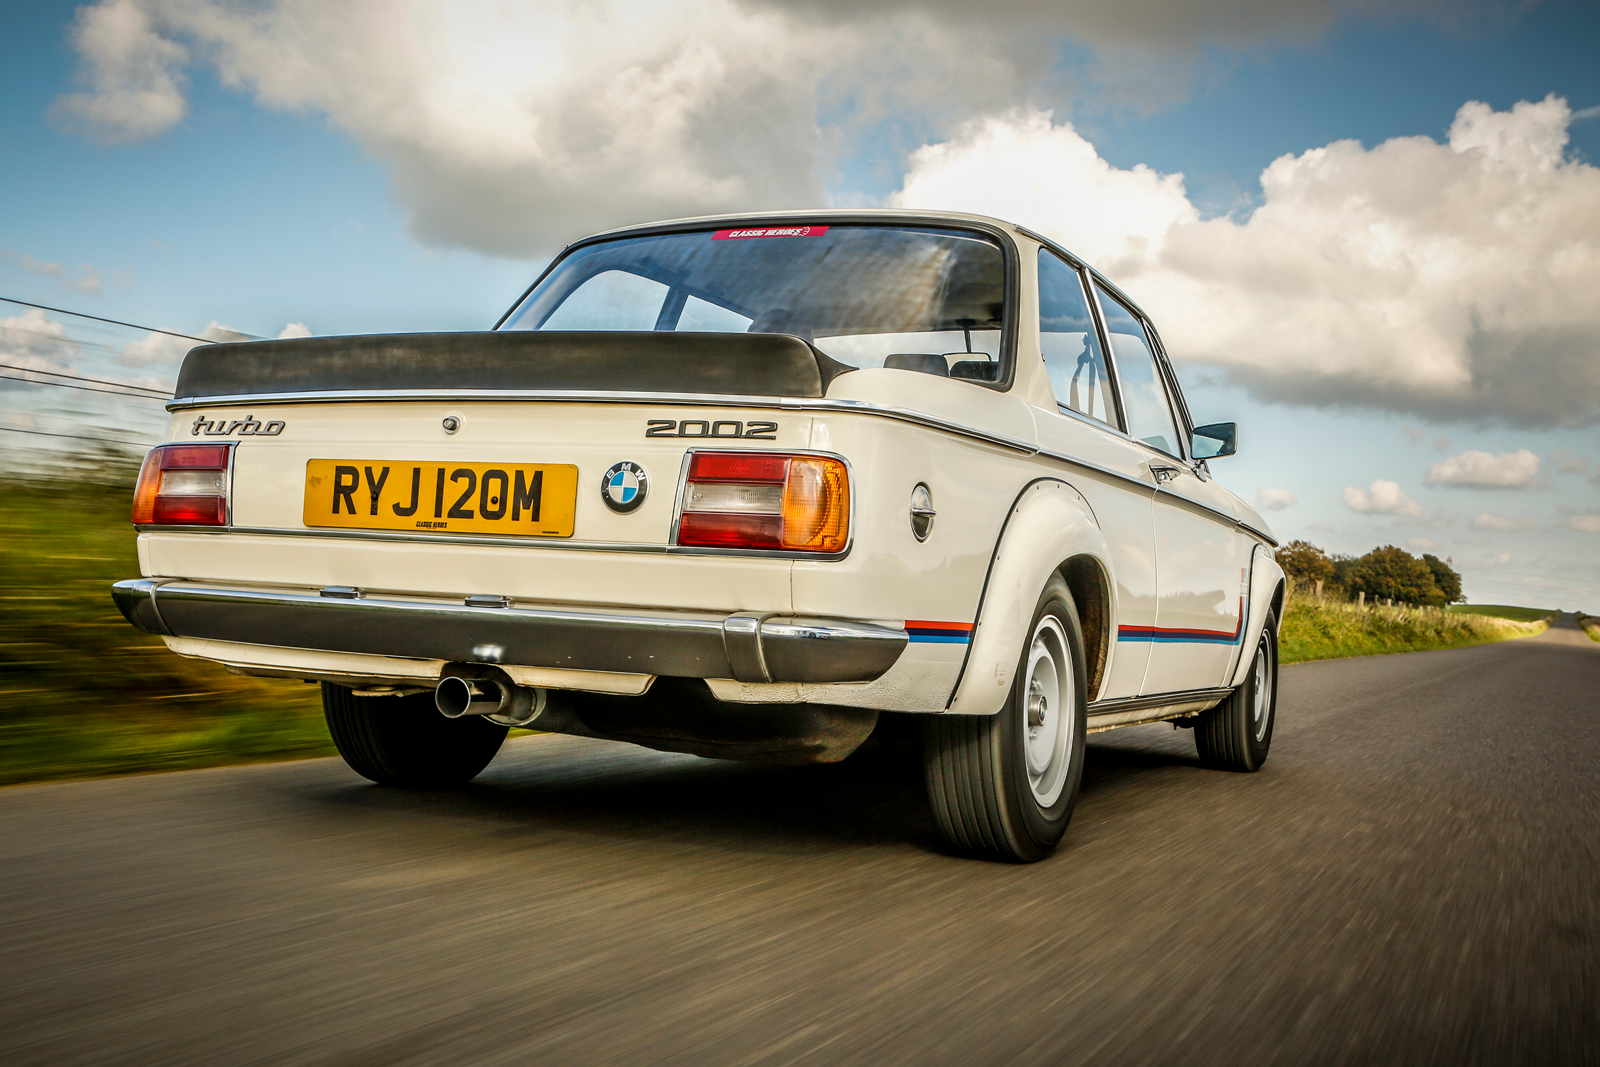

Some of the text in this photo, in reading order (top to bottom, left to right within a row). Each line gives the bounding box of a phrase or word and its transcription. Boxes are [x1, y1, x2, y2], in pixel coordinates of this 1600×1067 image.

[728, 228, 803, 238] CLASSIC HEROES
[191, 415, 286, 436] turbo
[645, 419, 778, 440] 2002
[606, 462, 646, 481] BMW
[332, 465, 544, 523] RYJ 120M
